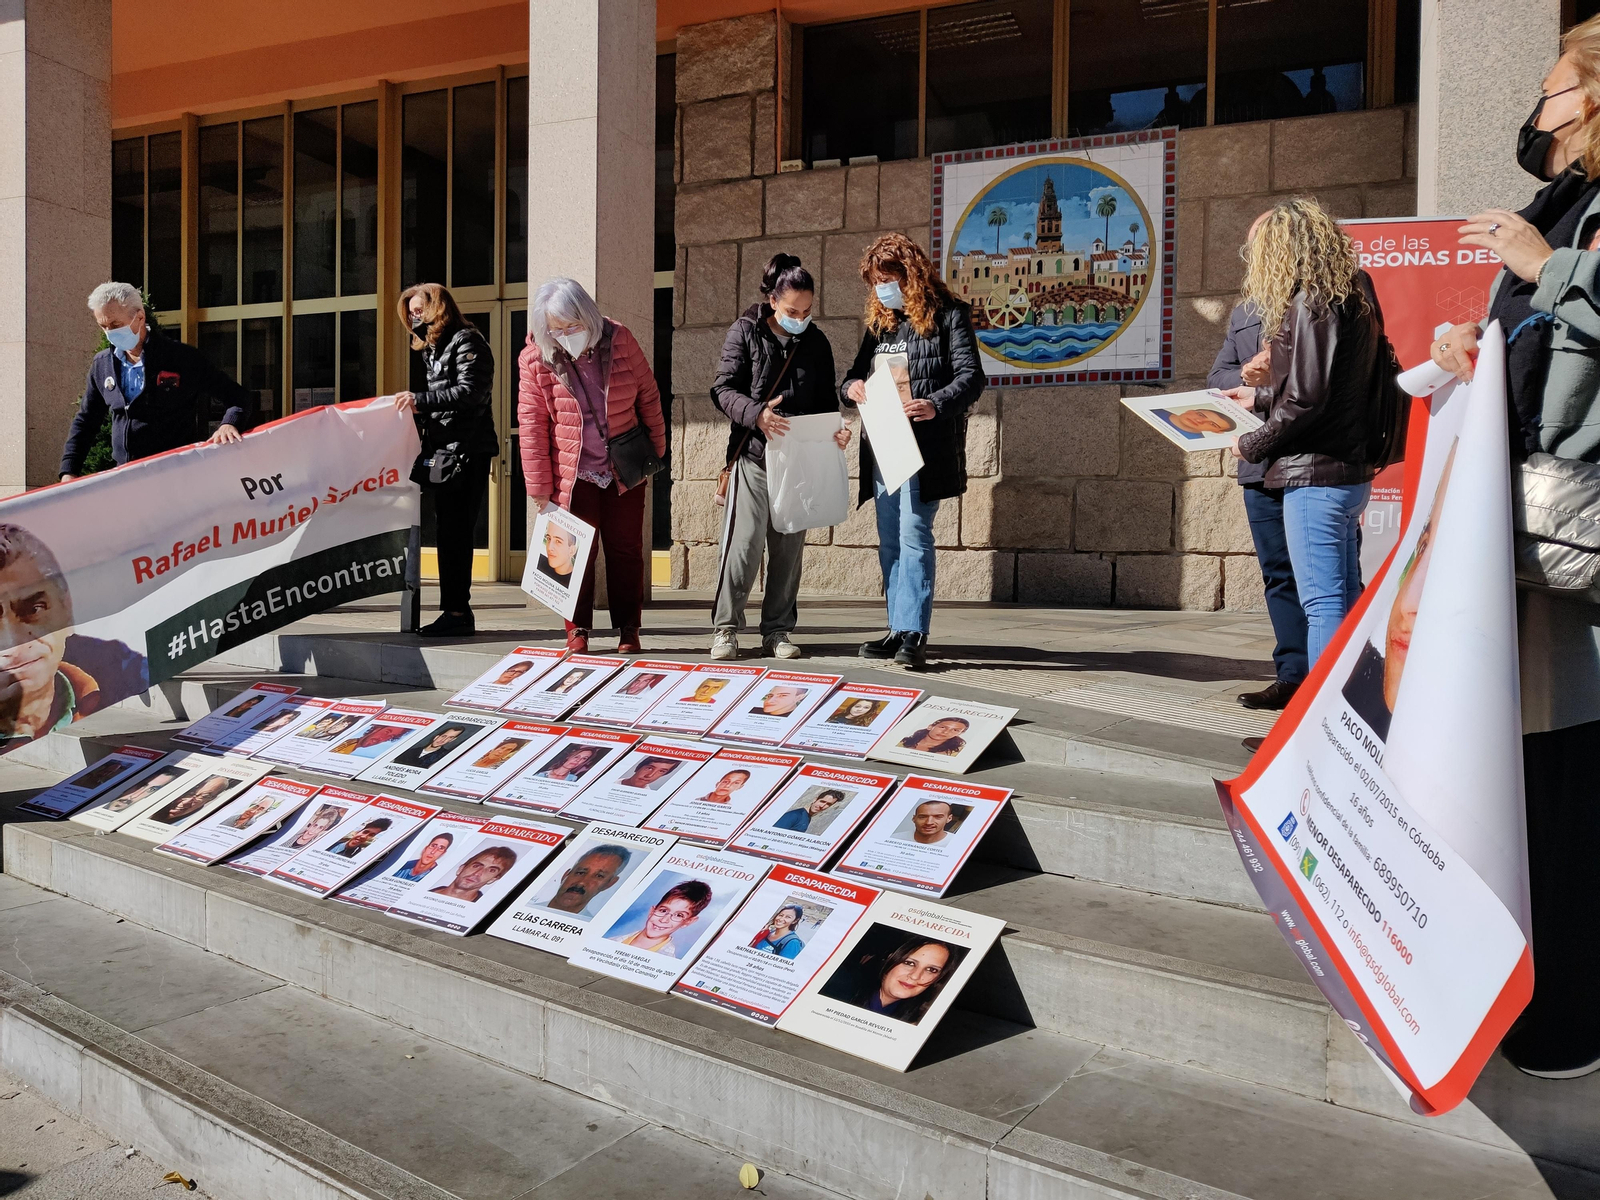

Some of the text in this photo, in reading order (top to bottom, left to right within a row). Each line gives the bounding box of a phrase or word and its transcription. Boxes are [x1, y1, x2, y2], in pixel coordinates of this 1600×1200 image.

[1370, 235, 1430, 251] de las
[1357, 249, 1504, 268] RSONAS DES
[240, 473, 284, 500] Por
[132, 525, 222, 584] Rafael
[232, 497, 319, 544] Muriel
[700, 666, 756, 675] DESAPARECIDO
[790, 675, 833, 683] DESAPARECIDO
[842, 685, 914, 697] MENOR DESAPARECIDA
[447, 714, 497, 726] DESAPARECIDO
[922, 703, 1004, 720] DESAPARECIDA
[513, 723, 551, 733] DESAPARECIDA
[579, 731, 621, 741] DESAPARECIDA
[1340, 711, 1384, 769] PACO MOLI
[638, 744, 711, 760] MENOR DESAPARECIDO
[719, 752, 793, 765] MENOR DESAPARECIDO
[811, 769, 878, 786] DESAPARECIDO
[263, 780, 311, 796] DESAPARECIDO
[922, 782, 981, 797] DESAPARECIDO
[1321, 717, 1445, 872] Desaparecido el 02/07/2015 en Córdoba
[378, 800, 426, 818] DESAPARECIDO
[1349, 792, 1374, 828] 16 años
[485, 824, 557, 843] DESAPARECIDO
[591, 826, 665, 847] DESAPARECIDO
[1242, 843, 1255, 861] 461
[1250, 857, 1264, 873] 932
[1314, 783, 1344, 823] confidencial
[1341, 819, 1349, 830] de
[1352, 834, 1374, 863] familia:
[1373, 857, 1428, 929] 689950710
[667, 855, 755, 883] DESAPARECIDO
[784, 872, 858, 900] DESAPARECIDA
[1305, 814, 1413, 966] MENOR DESAPARECIDO 116000
[512, 911, 584, 937] ELÍAS CARRERA
[890, 911, 971, 940] DESAPARECIDA
[511, 925, 565, 944] LLAMAR AL 091
[581, 946, 615, 959] Desaparecido
[629, 954, 651, 963] VARGAS
[733, 945, 796, 966] NATHALY SALAZAR AYALA
[1311, 873, 1331, 903] (062),
[1331, 899, 1345, 921] 112
[1342, 919, 1349, 929] o
[1347, 924, 1421, 1036] info@qsdglobal.com
[832, 1010, 851, 1019] PIEDAD
[849, 1015, 870, 1025] GARCÍA
[867, 1021, 894, 1033] REVUELTA
